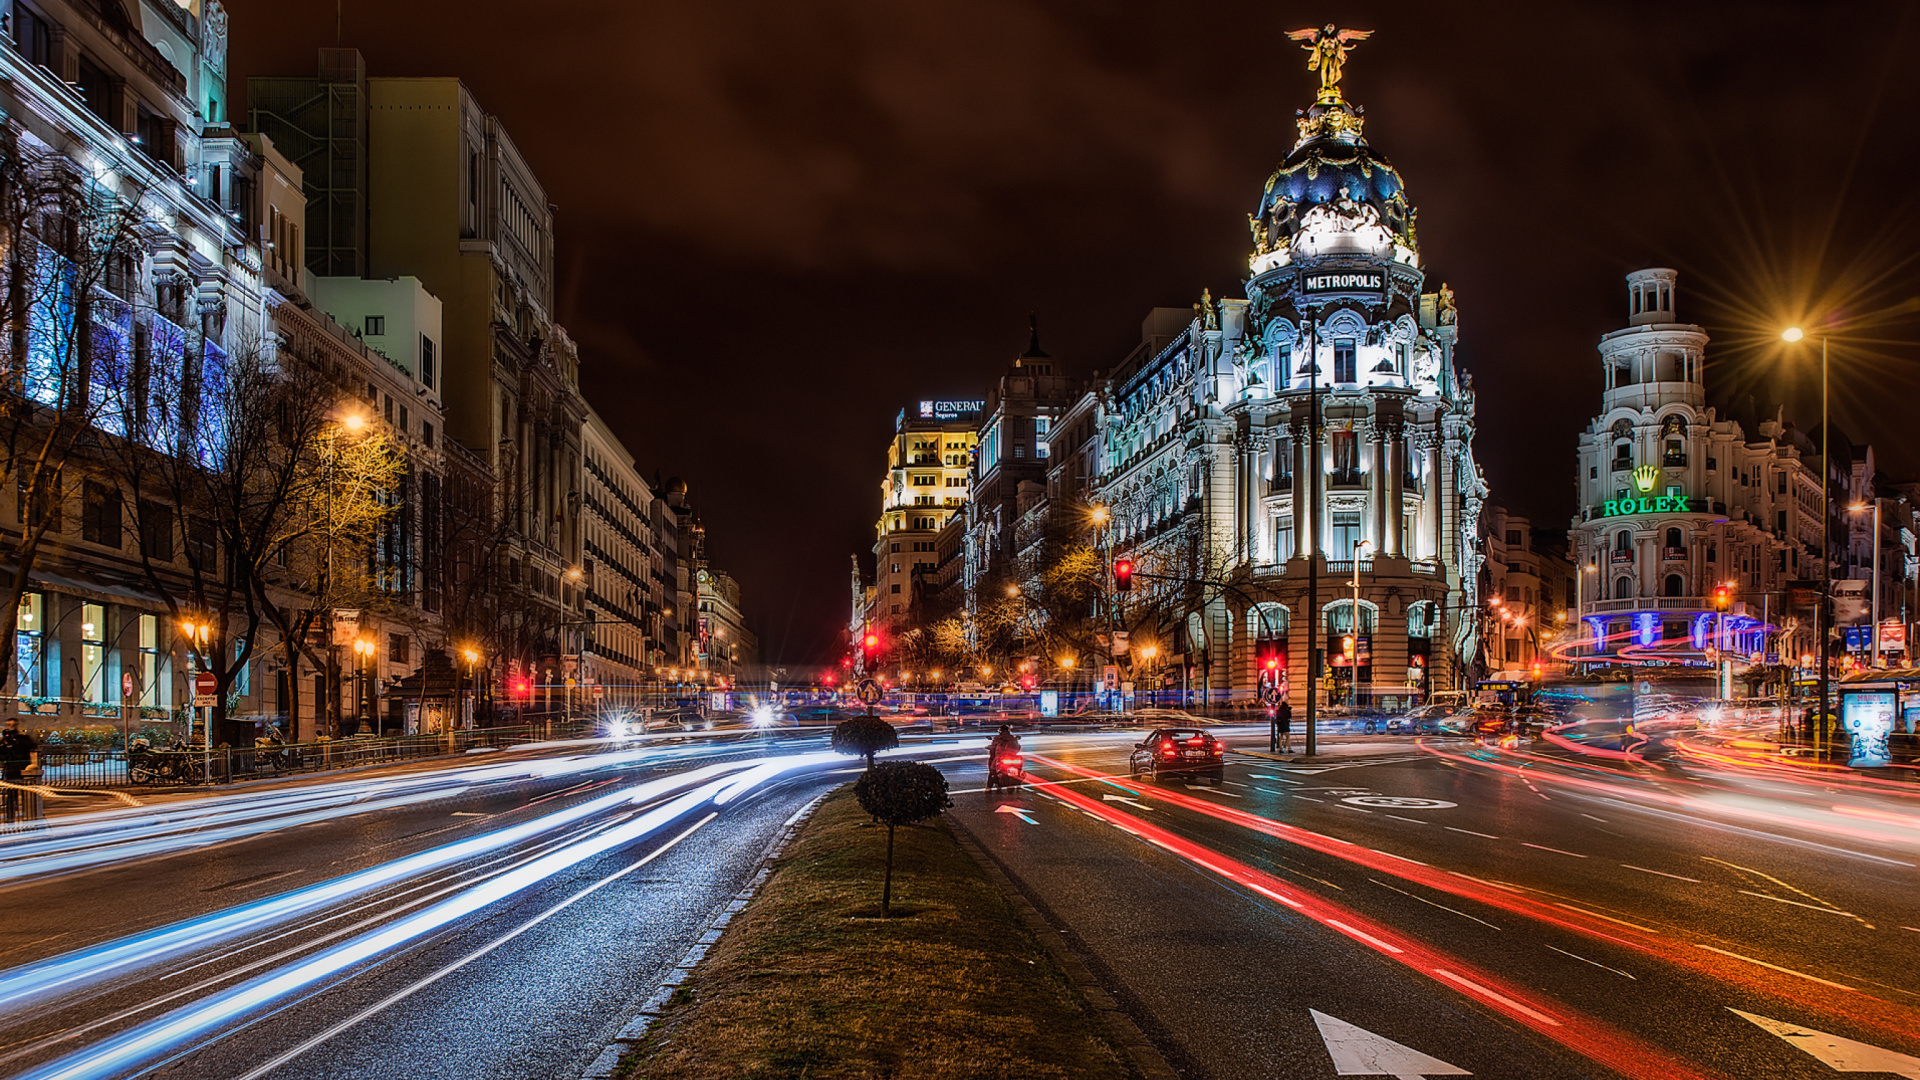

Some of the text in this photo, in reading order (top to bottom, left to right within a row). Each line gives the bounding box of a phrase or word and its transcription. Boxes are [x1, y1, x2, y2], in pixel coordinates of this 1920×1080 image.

[1307, 274, 1381, 290] METROPOLIS
[935, 411, 958, 419] Seguros
[1603, 496, 1690, 517] ROLEX
